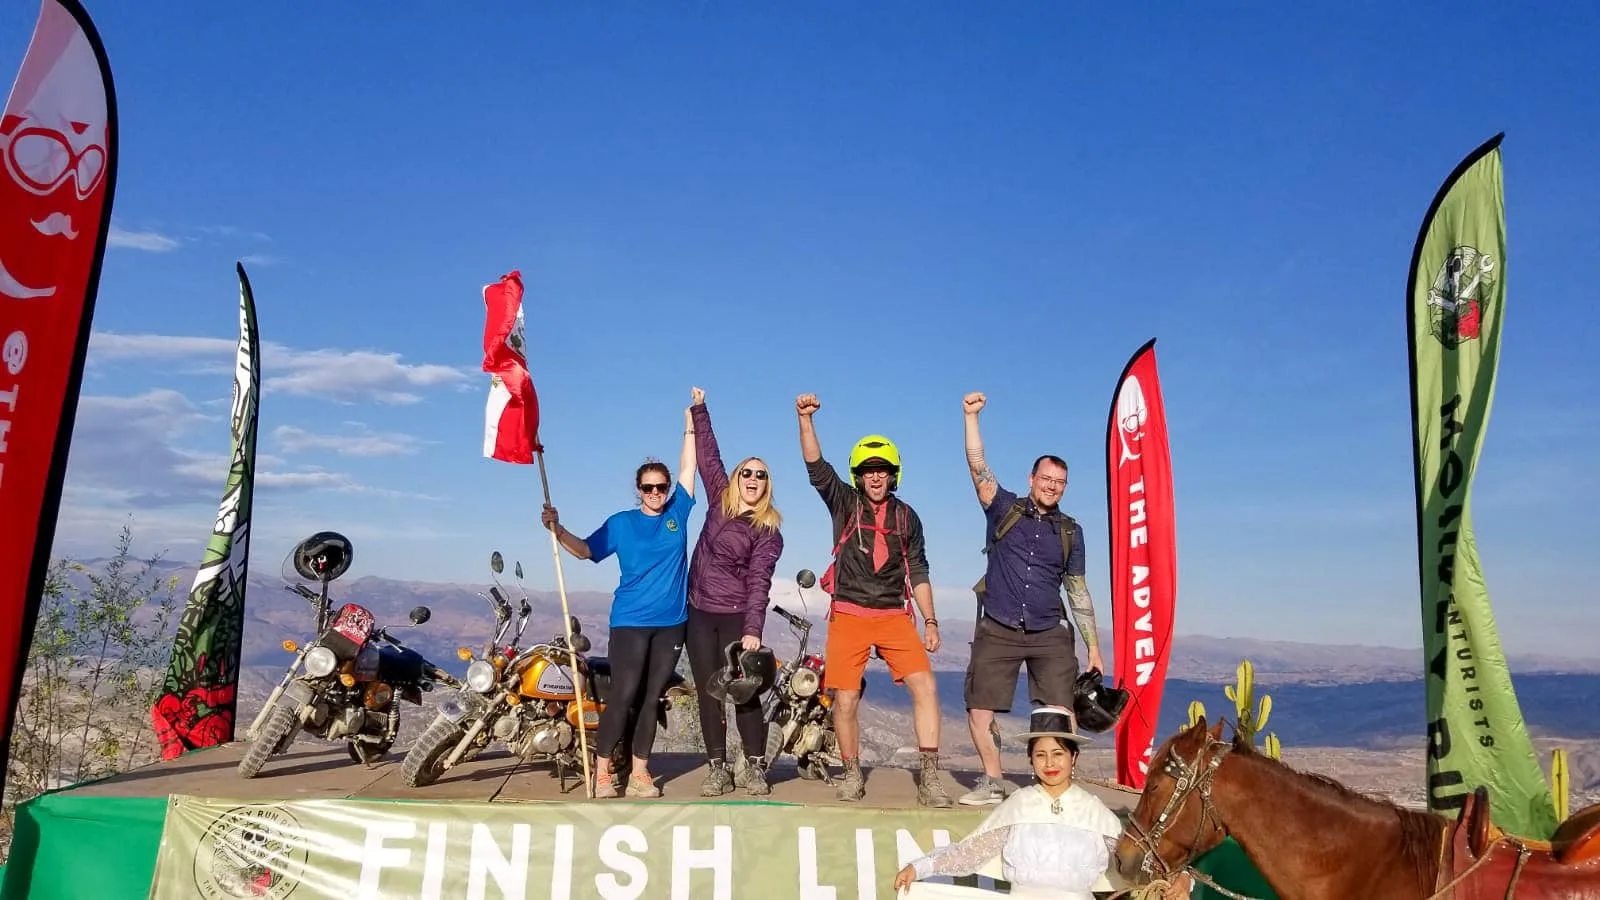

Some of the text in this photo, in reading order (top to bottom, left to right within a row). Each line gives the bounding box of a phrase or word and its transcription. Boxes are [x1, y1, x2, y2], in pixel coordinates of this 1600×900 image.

[1129, 475, 1156, 686] THE ADVEN
[257, 810, 279, 821] RUN
[358, 821, 950, 900] FINISH LIN
